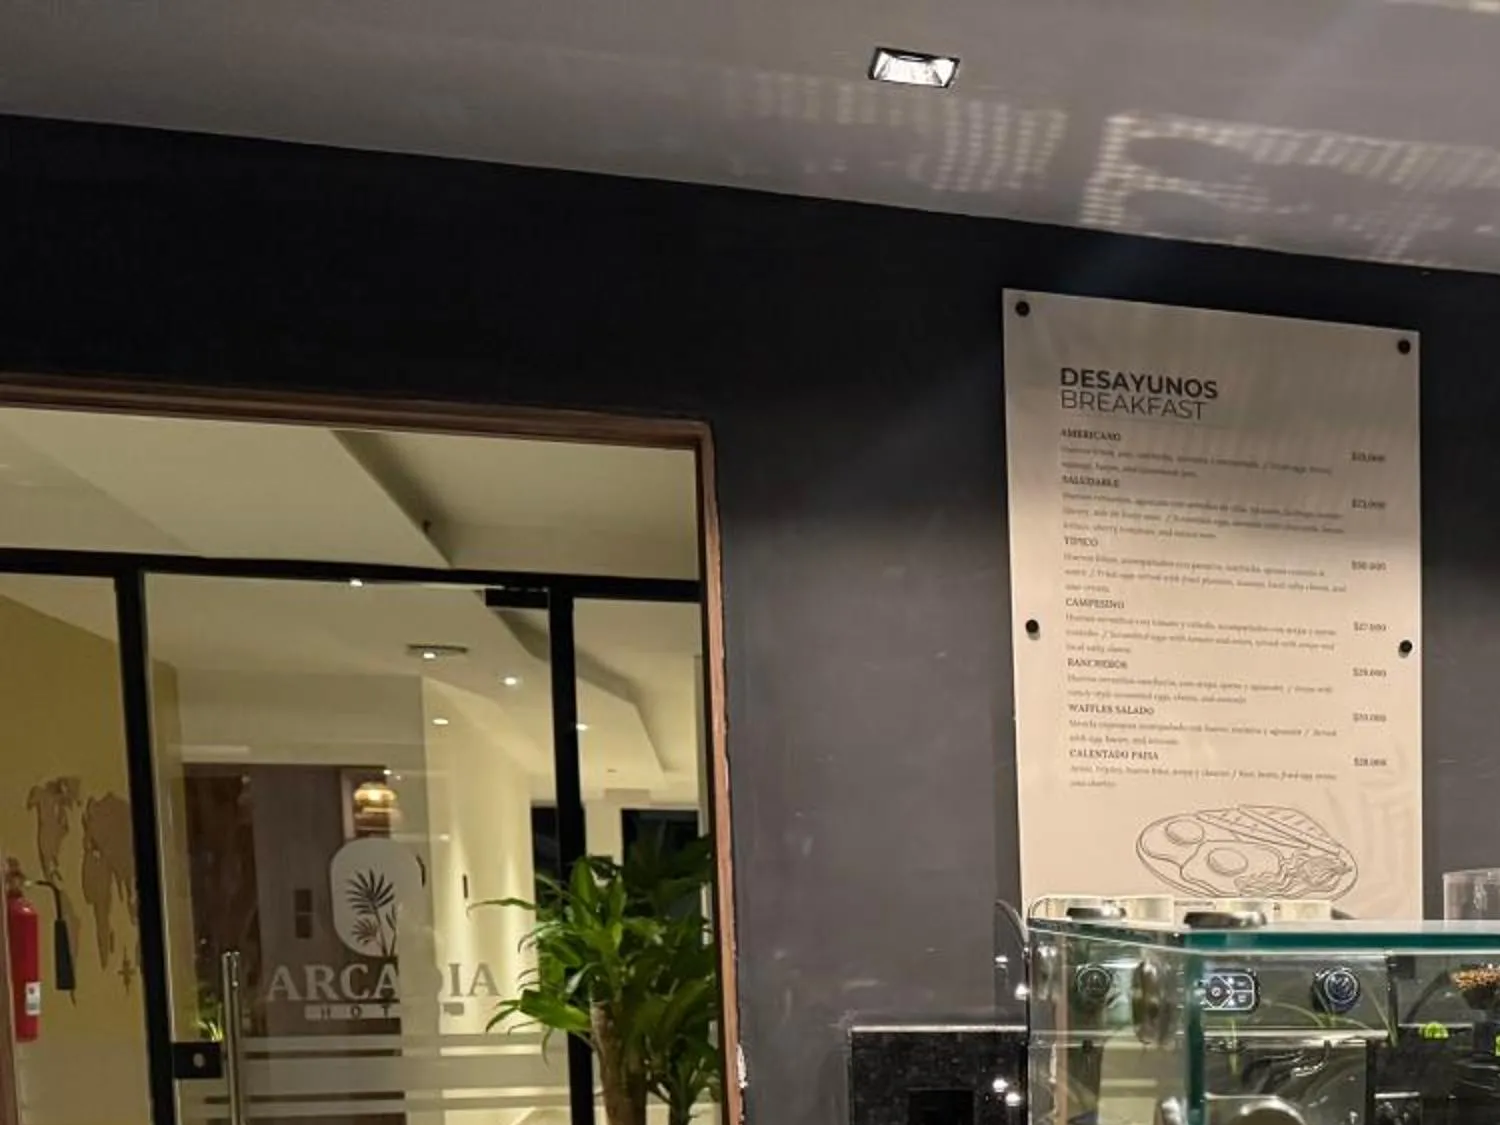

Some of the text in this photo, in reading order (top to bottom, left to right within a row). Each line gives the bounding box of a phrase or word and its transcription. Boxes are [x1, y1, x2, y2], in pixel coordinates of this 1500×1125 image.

[1060, 367, 1219, 399] DESAYUNOS
[1061, 390, 1207, 421] BREAKFAST
[1069, 749, 1128, 759] CALENTADO
